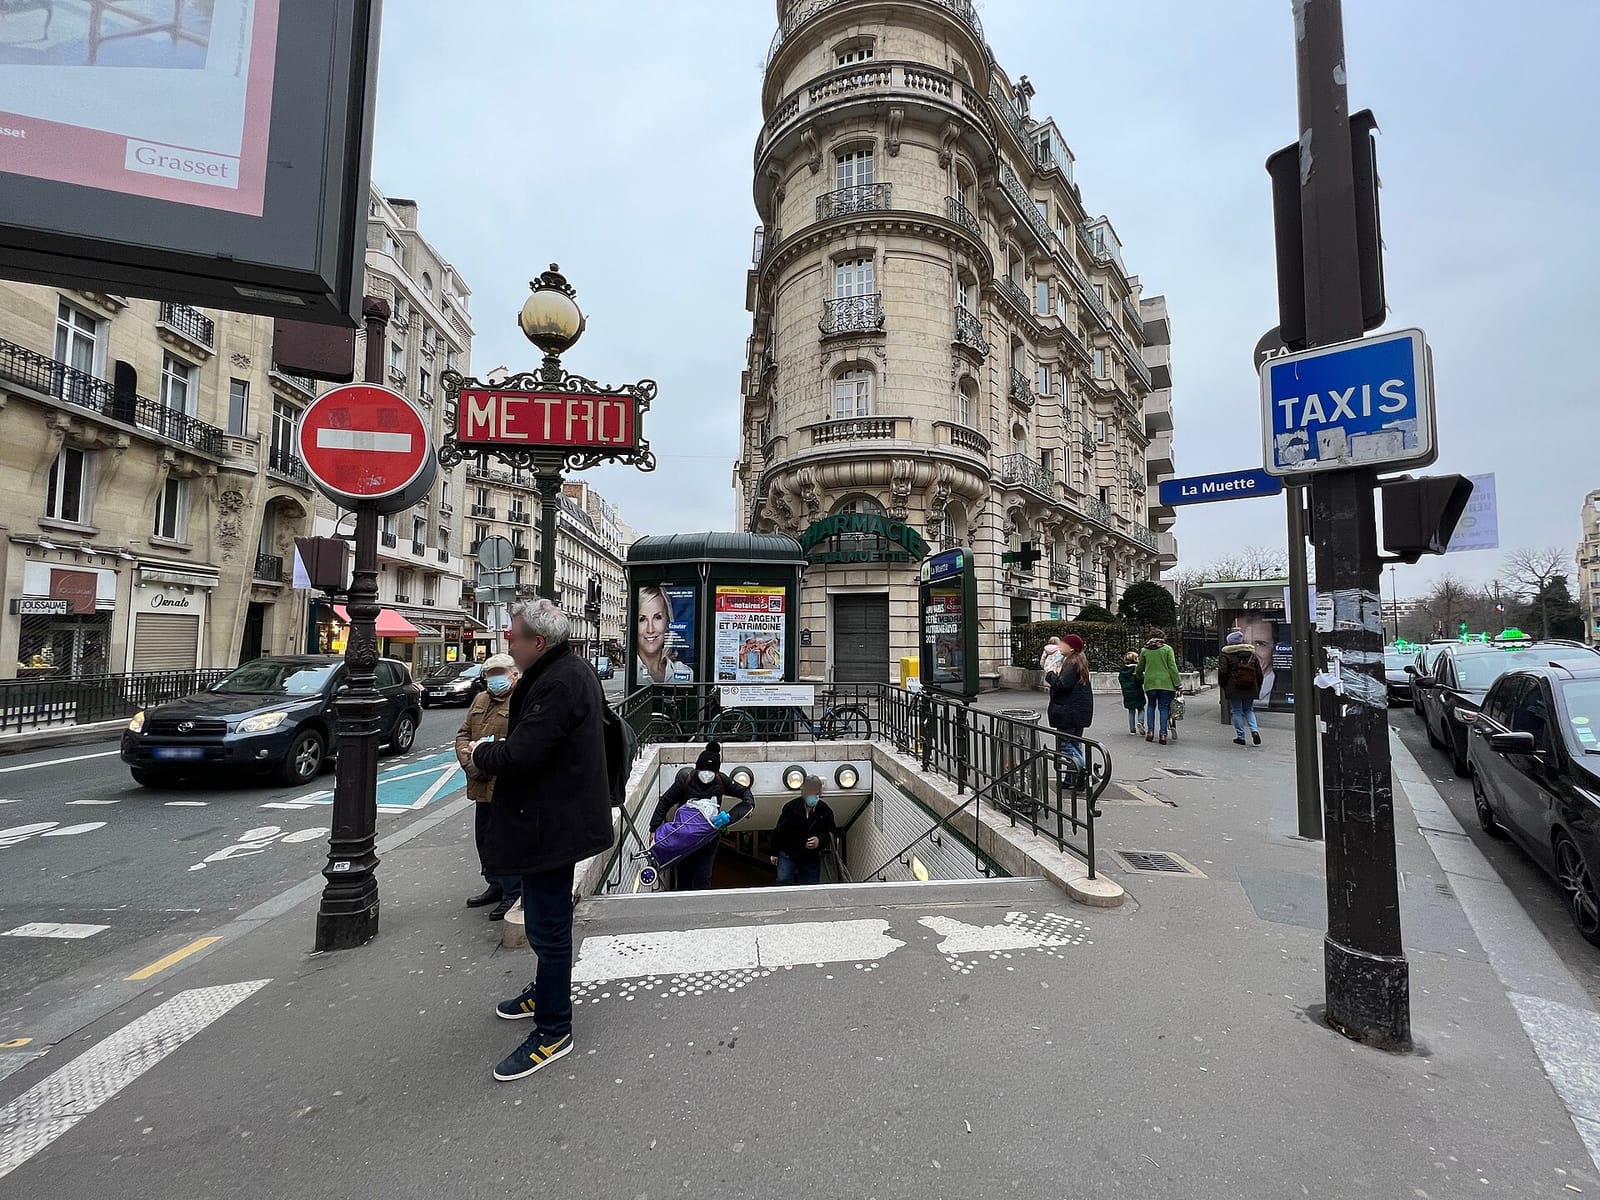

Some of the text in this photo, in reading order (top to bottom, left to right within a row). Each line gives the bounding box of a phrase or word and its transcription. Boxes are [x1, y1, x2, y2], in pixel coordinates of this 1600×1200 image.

[135, 147, 229, 178] Grasset
[1278, 379, 1408, 429] TAXIS
[467, 395, 626, 443] METRO
[1181, 477, 1255, 496] La Muette
[26, 548, 120, 567] OPTIQUE
[21, 601, 66, 610] JOUSSAUME
[151, 594, 189, 608] Ornato
[719, 622, 781, 631] ET PATRIMOINE
[748, 614, 781, 623] ARGENT
